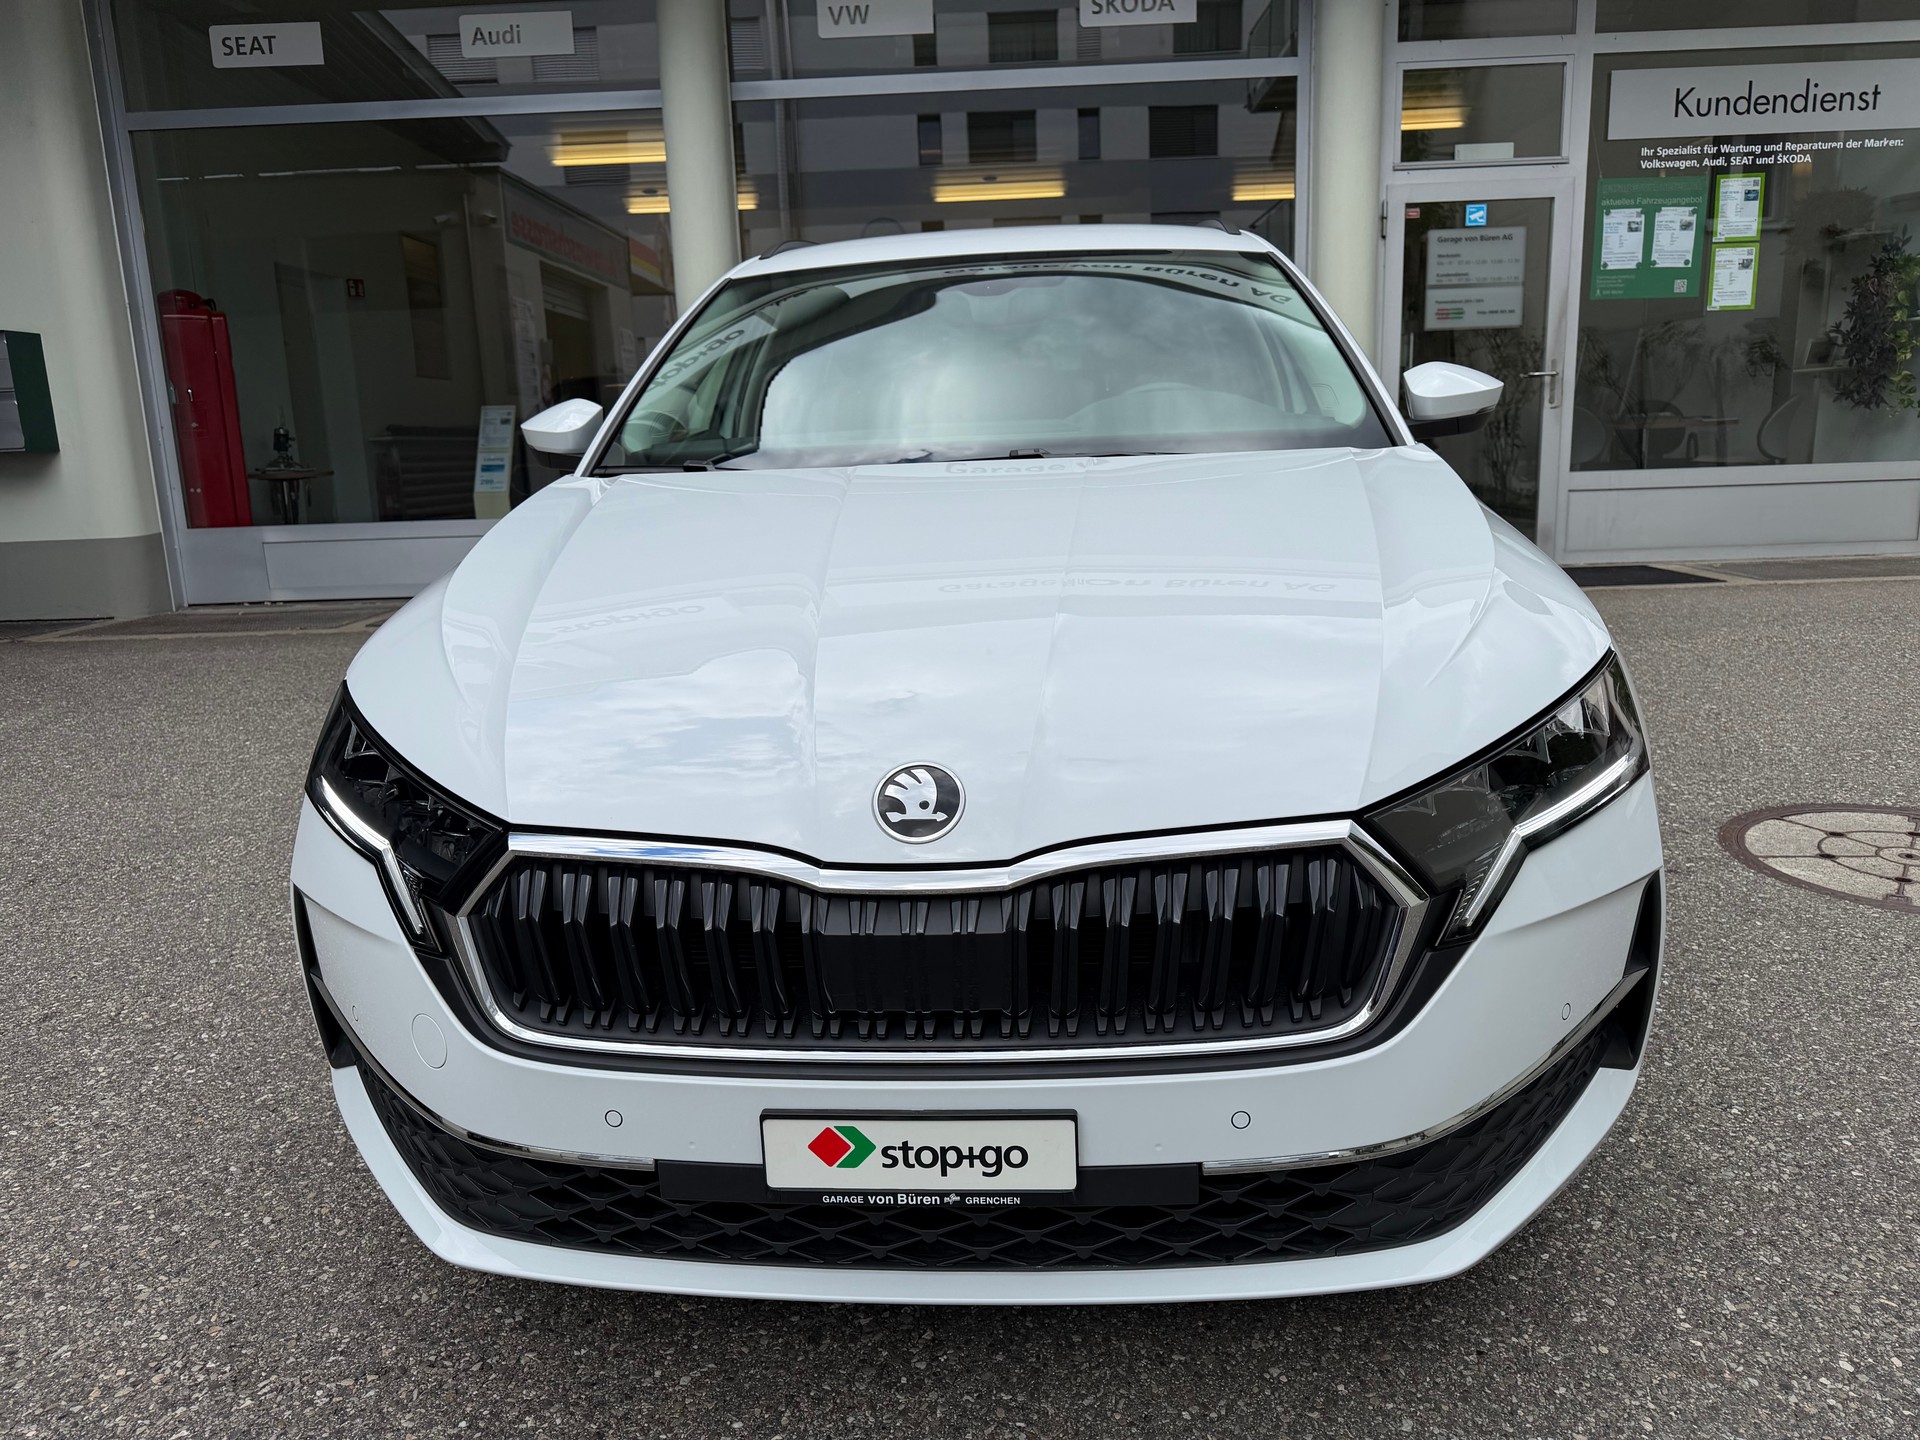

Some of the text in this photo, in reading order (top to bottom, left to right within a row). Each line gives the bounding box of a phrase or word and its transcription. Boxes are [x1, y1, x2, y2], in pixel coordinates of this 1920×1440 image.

[828, 4, 869, 26] VW
[221, 35, 276, 56] SEAT
[471, 24, 521, 46] Audi
[1673, 78, 1881, 118] Kundendienst
[1641, 147, 1655, 156] Ihr
[1656, 145, 1701, 158] Spezialist
[1703, 144, 1718, 154] für
[1720, 144, 1761, 154] Wartung
[1764, 142, 1782, 152] und
[1785, 141, 1843, 153] Reparaturen
[1846, 139, 1862, 149] der
[1640, 153, 1812, 170] Volkswagen, Audi, SEAT und ŠKODA
[1436, 235, 1463, 244] Garage
[1502, 233, 1514, 241] AG
[880, 1139, 1028, 1177] stop+go
[822, 1195, 864, 1204] GARAGE
[868, 1196, 894, 1205] von
[897, 1193, 940, 1205] Büren
[965, 1196, 1021, 1205] GRENCHEN
